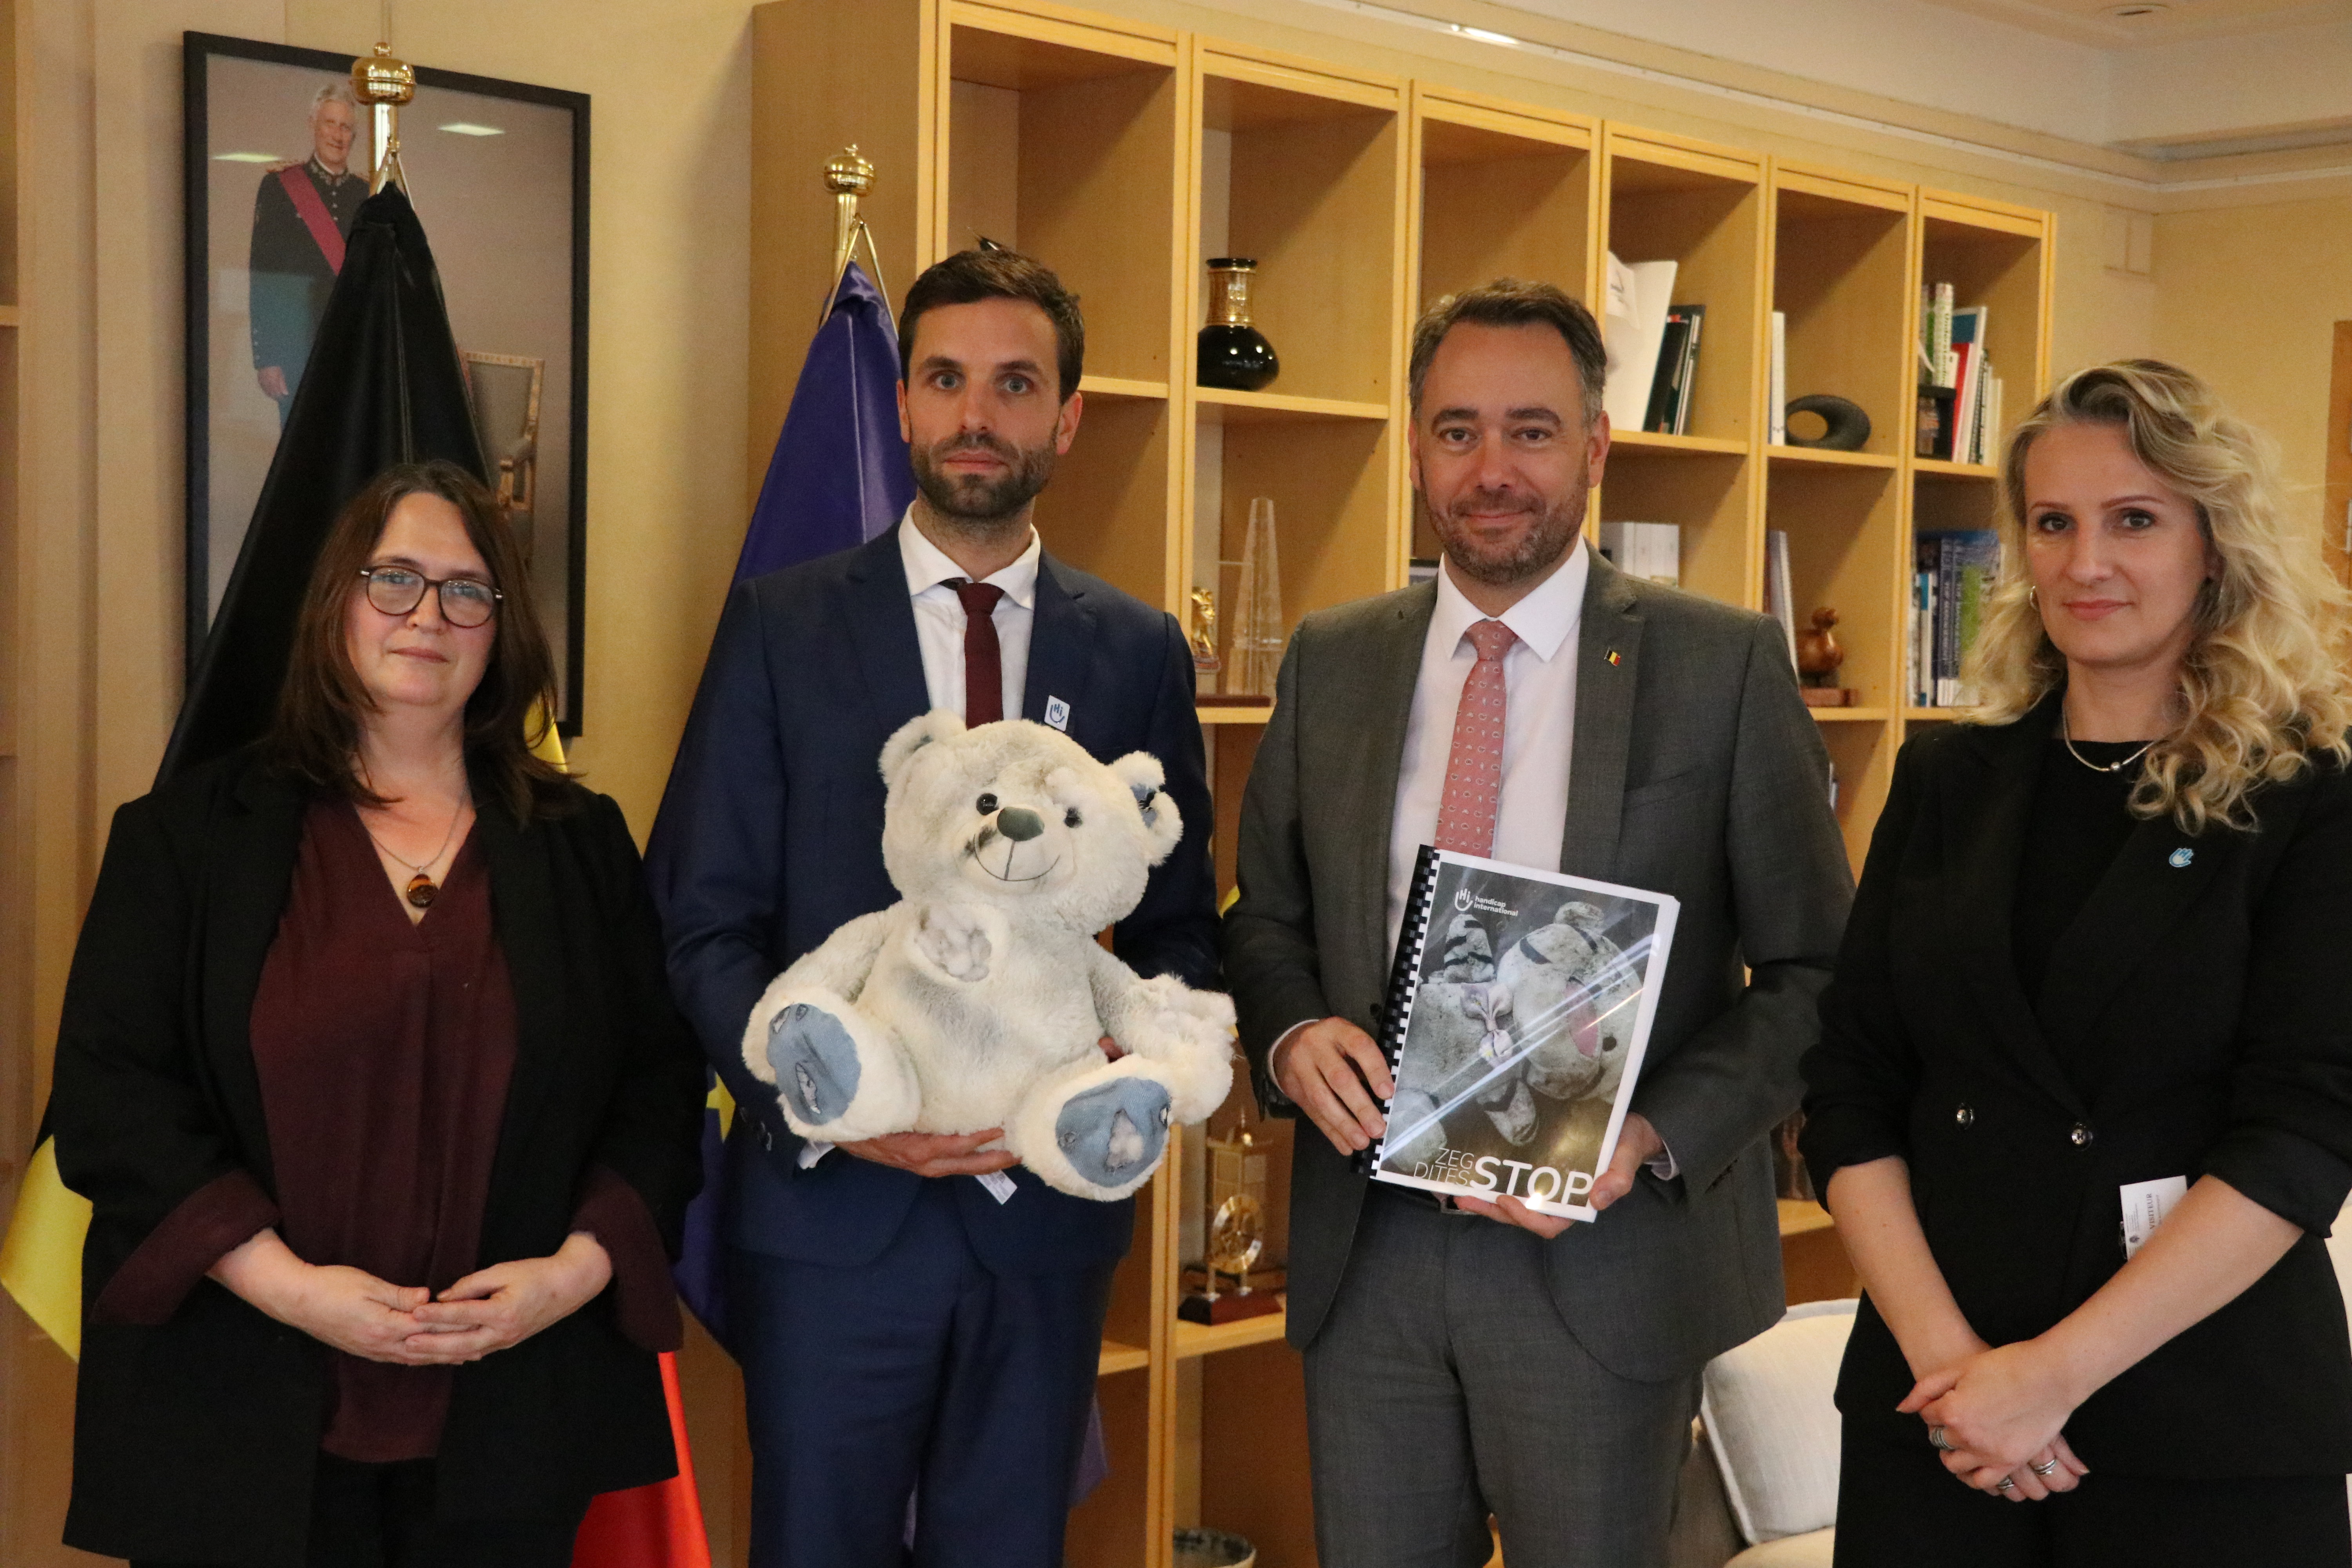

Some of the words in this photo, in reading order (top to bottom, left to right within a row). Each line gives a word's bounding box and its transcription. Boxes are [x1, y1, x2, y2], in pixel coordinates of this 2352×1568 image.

[1474, 902, 1518, 916] international
[1475, 895, 1506, 907] handicap
[1435, 1147, 1475, 1169] ZEG
[1414, 1161, 1470, 1186] DITES
[1469, 1156, 1594, 1205] STOP
[2147, 1194, 2155, 1229] VISITEUR
